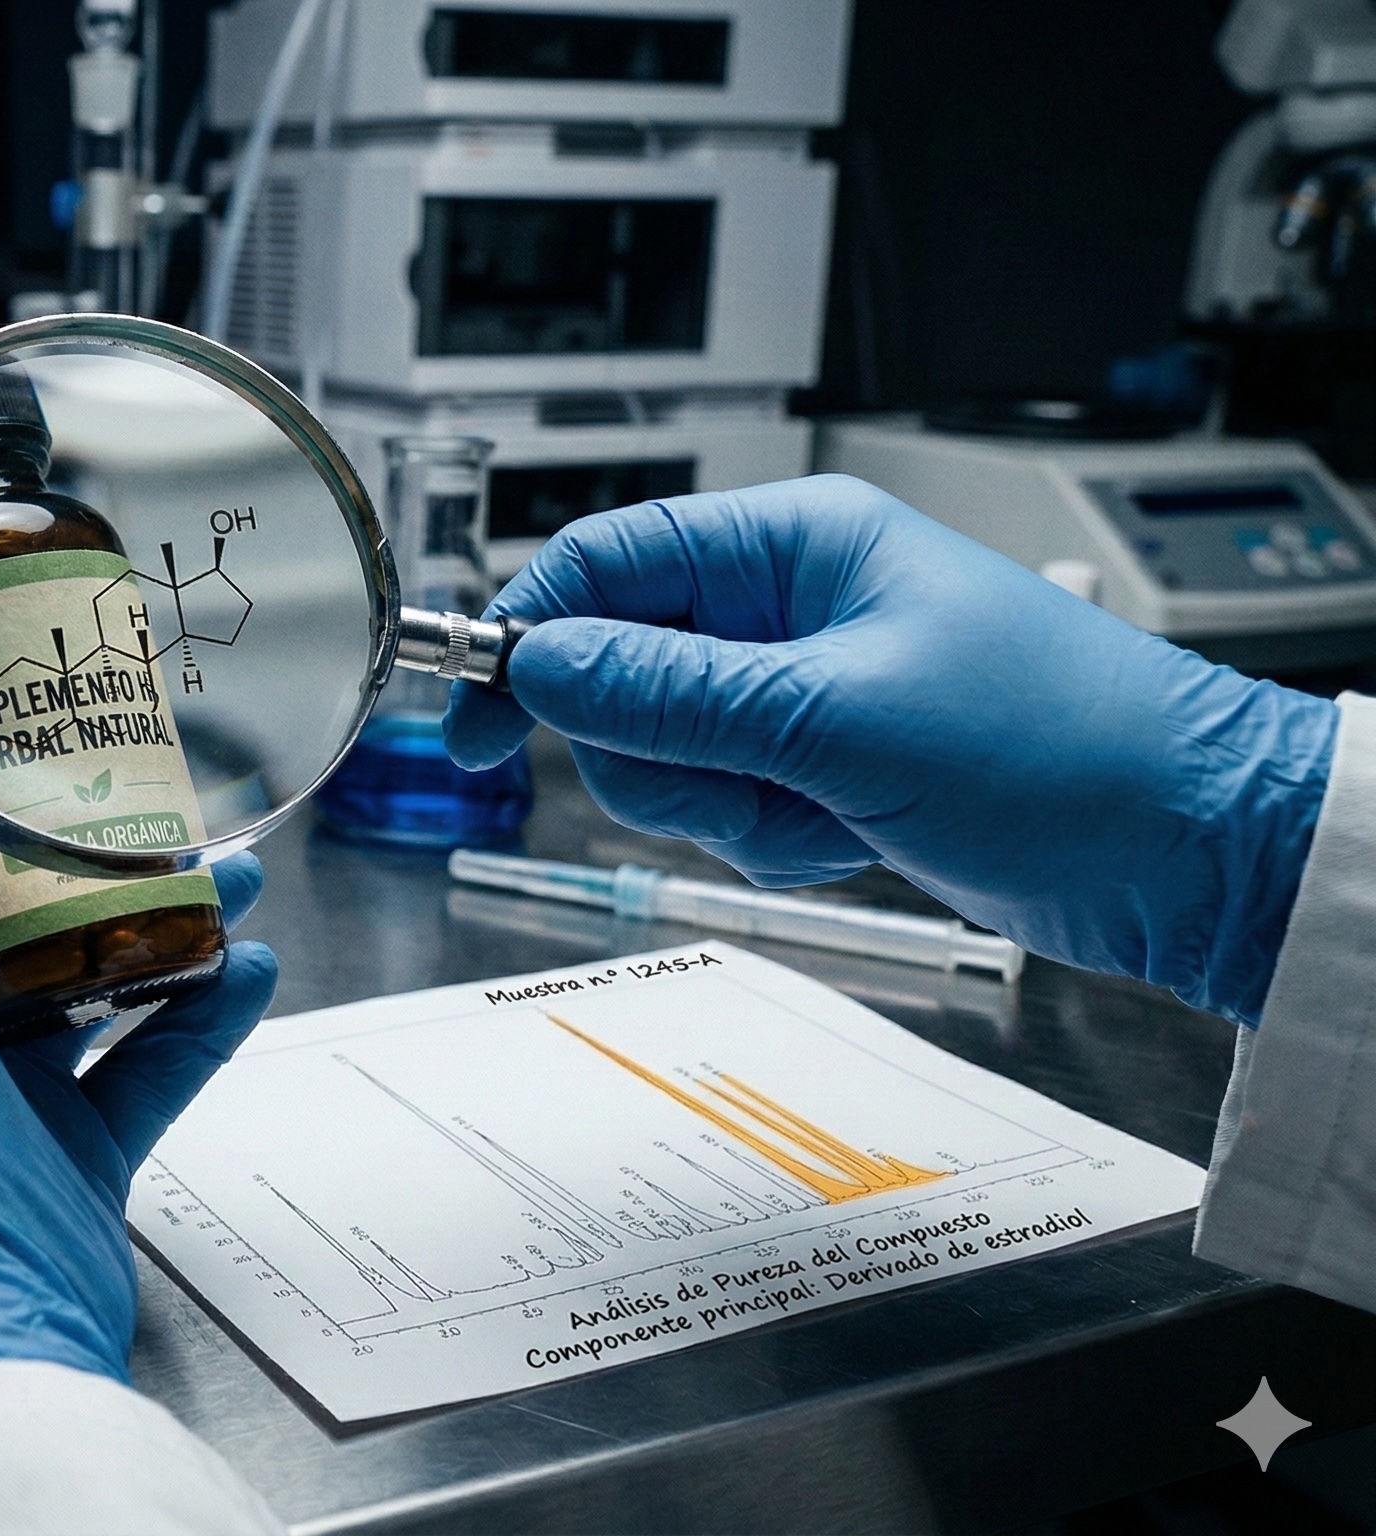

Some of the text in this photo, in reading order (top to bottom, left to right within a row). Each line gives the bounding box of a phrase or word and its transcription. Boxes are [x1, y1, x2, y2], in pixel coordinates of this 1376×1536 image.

[210, 506, 257, 535] OH
[128, 603, 150, 628] H
[182, 669, 204, 694] H
[77, 713, 174, 751] NATURAL
[103, 817, 183, 848] ORGÁNICA
[484, 979, 584, 1006] Muestra
[627, 952, 723, 979] 1245-A
[570, 1291, 670, 1330] Análisis
[677, 1282, 708, 1302] de
[712, 1260, 806, 1291] Pureza
[811, 1243, 851, 1268] del
[856, 1211, 991, 1256] Compuesto
[526, 1208, 1093, 1369] Componente principal: Derivado de estradiol
